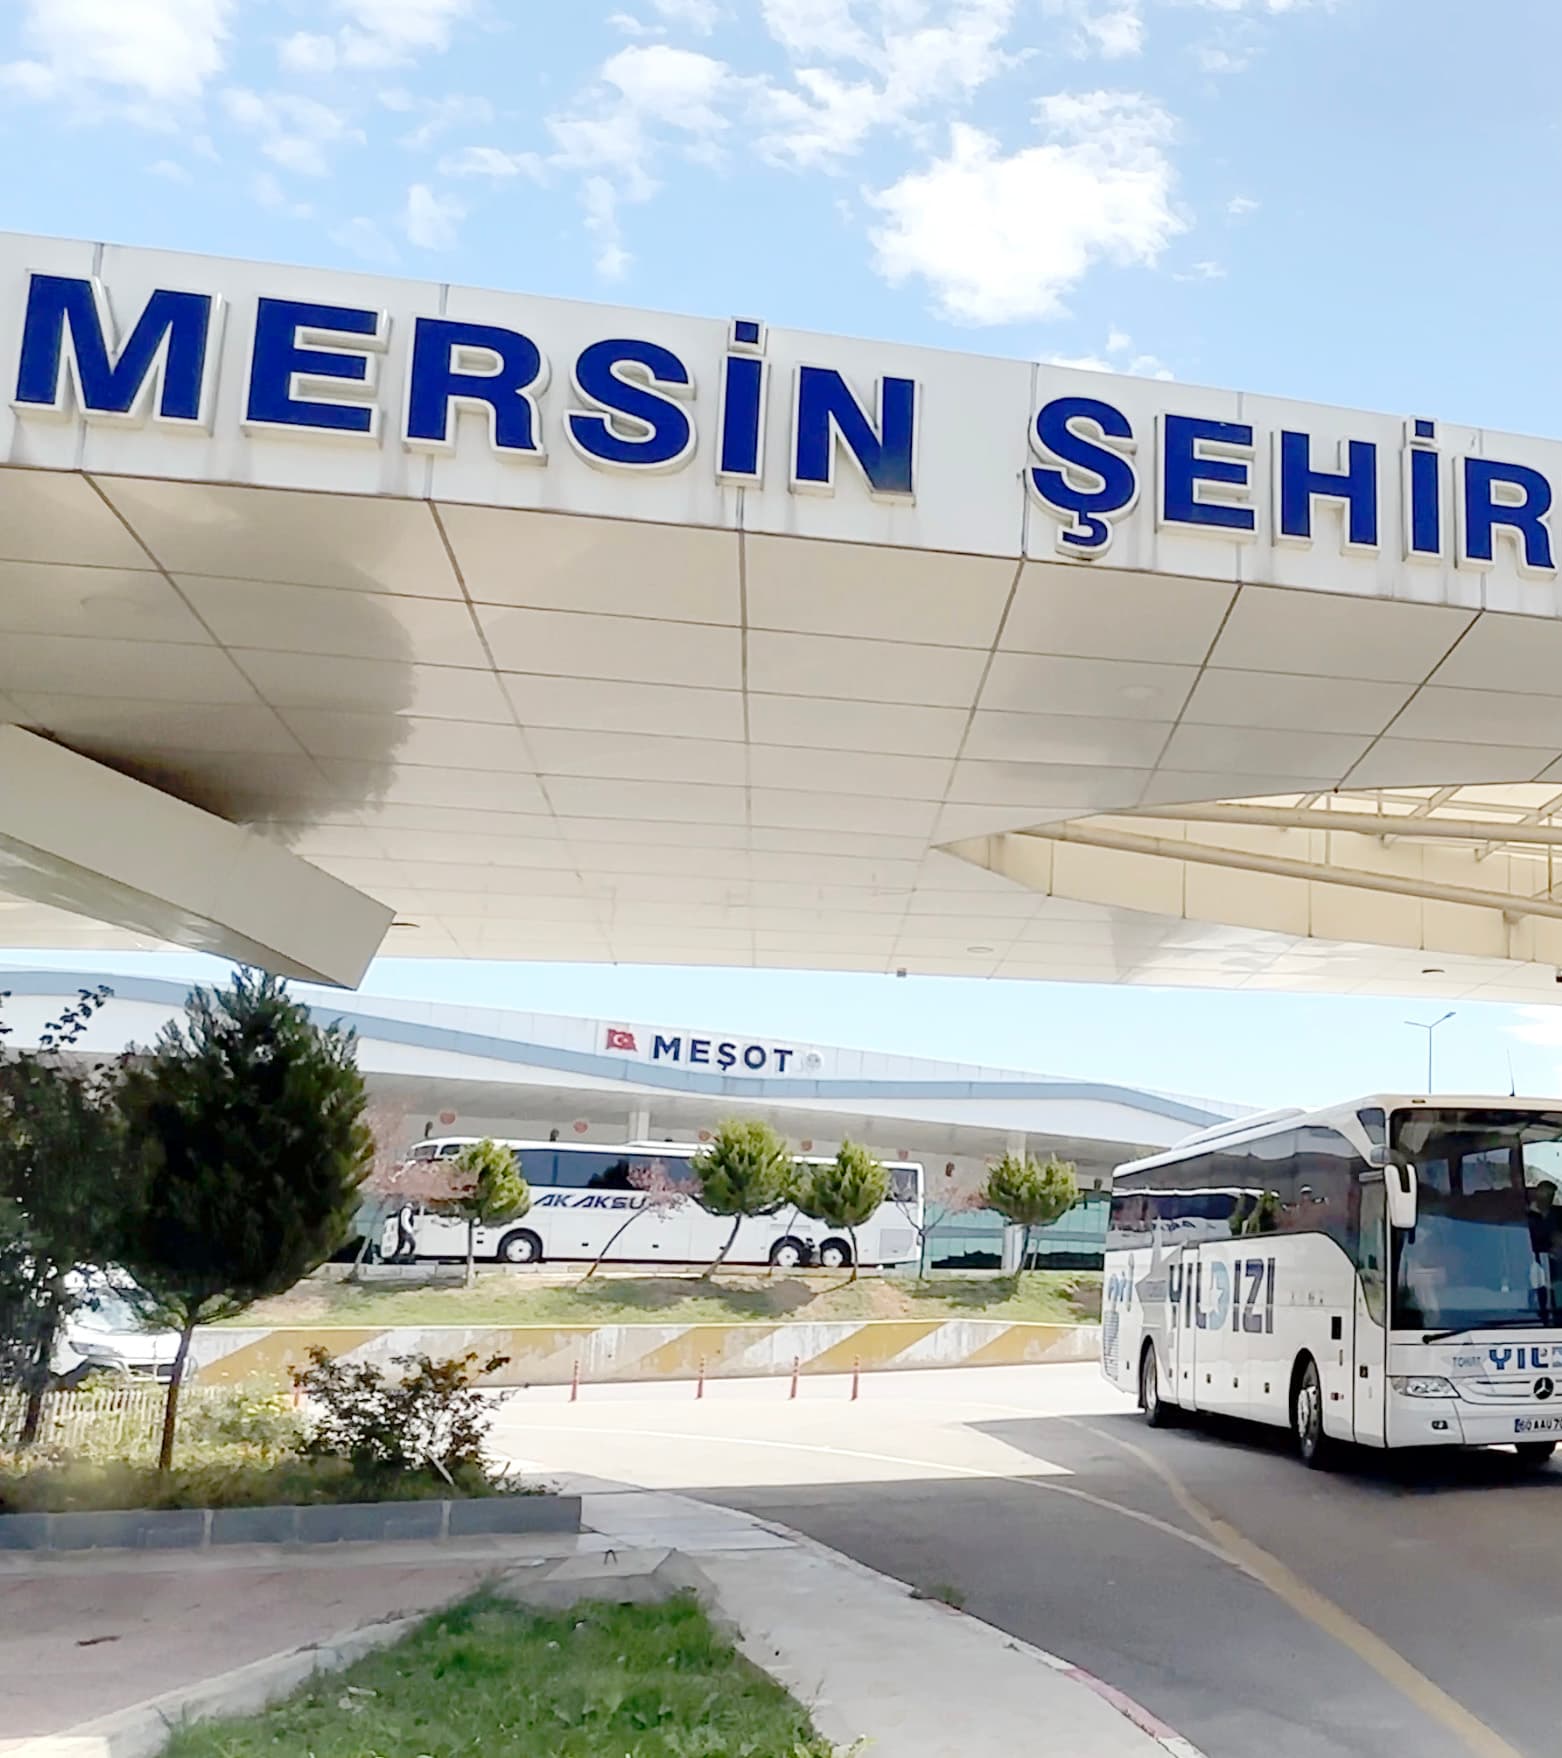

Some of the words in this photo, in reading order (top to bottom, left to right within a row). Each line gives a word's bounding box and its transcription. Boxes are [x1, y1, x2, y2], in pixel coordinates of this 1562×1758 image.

[14, 271, 920, 496] MERSİN
[652, 1034, 793, 1072] MEŞOT
[1168, 1257, 1276, 1334] YILDIZI
